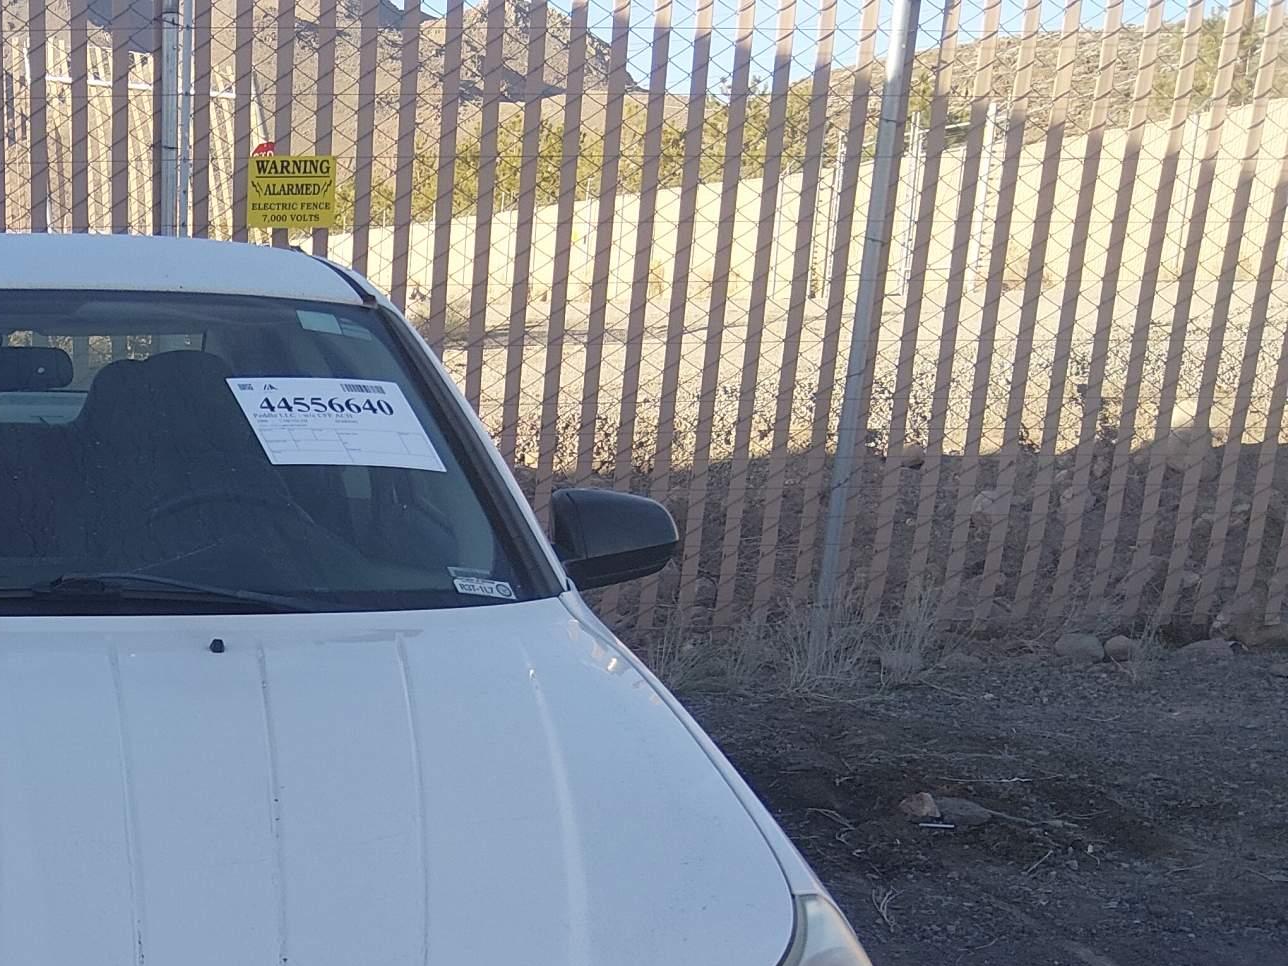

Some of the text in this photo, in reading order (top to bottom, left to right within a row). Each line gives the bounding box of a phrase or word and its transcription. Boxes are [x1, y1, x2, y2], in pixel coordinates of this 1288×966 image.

[256, 159, 331, 174] WARNING
[264, 183, 321, 195] ALARMED
[252, 202, 331, 210] ELECTRIC FENCE
[262, 214, 320, 223] 7,000 VOLTS
[259, 397, 394, 416] 44556640
